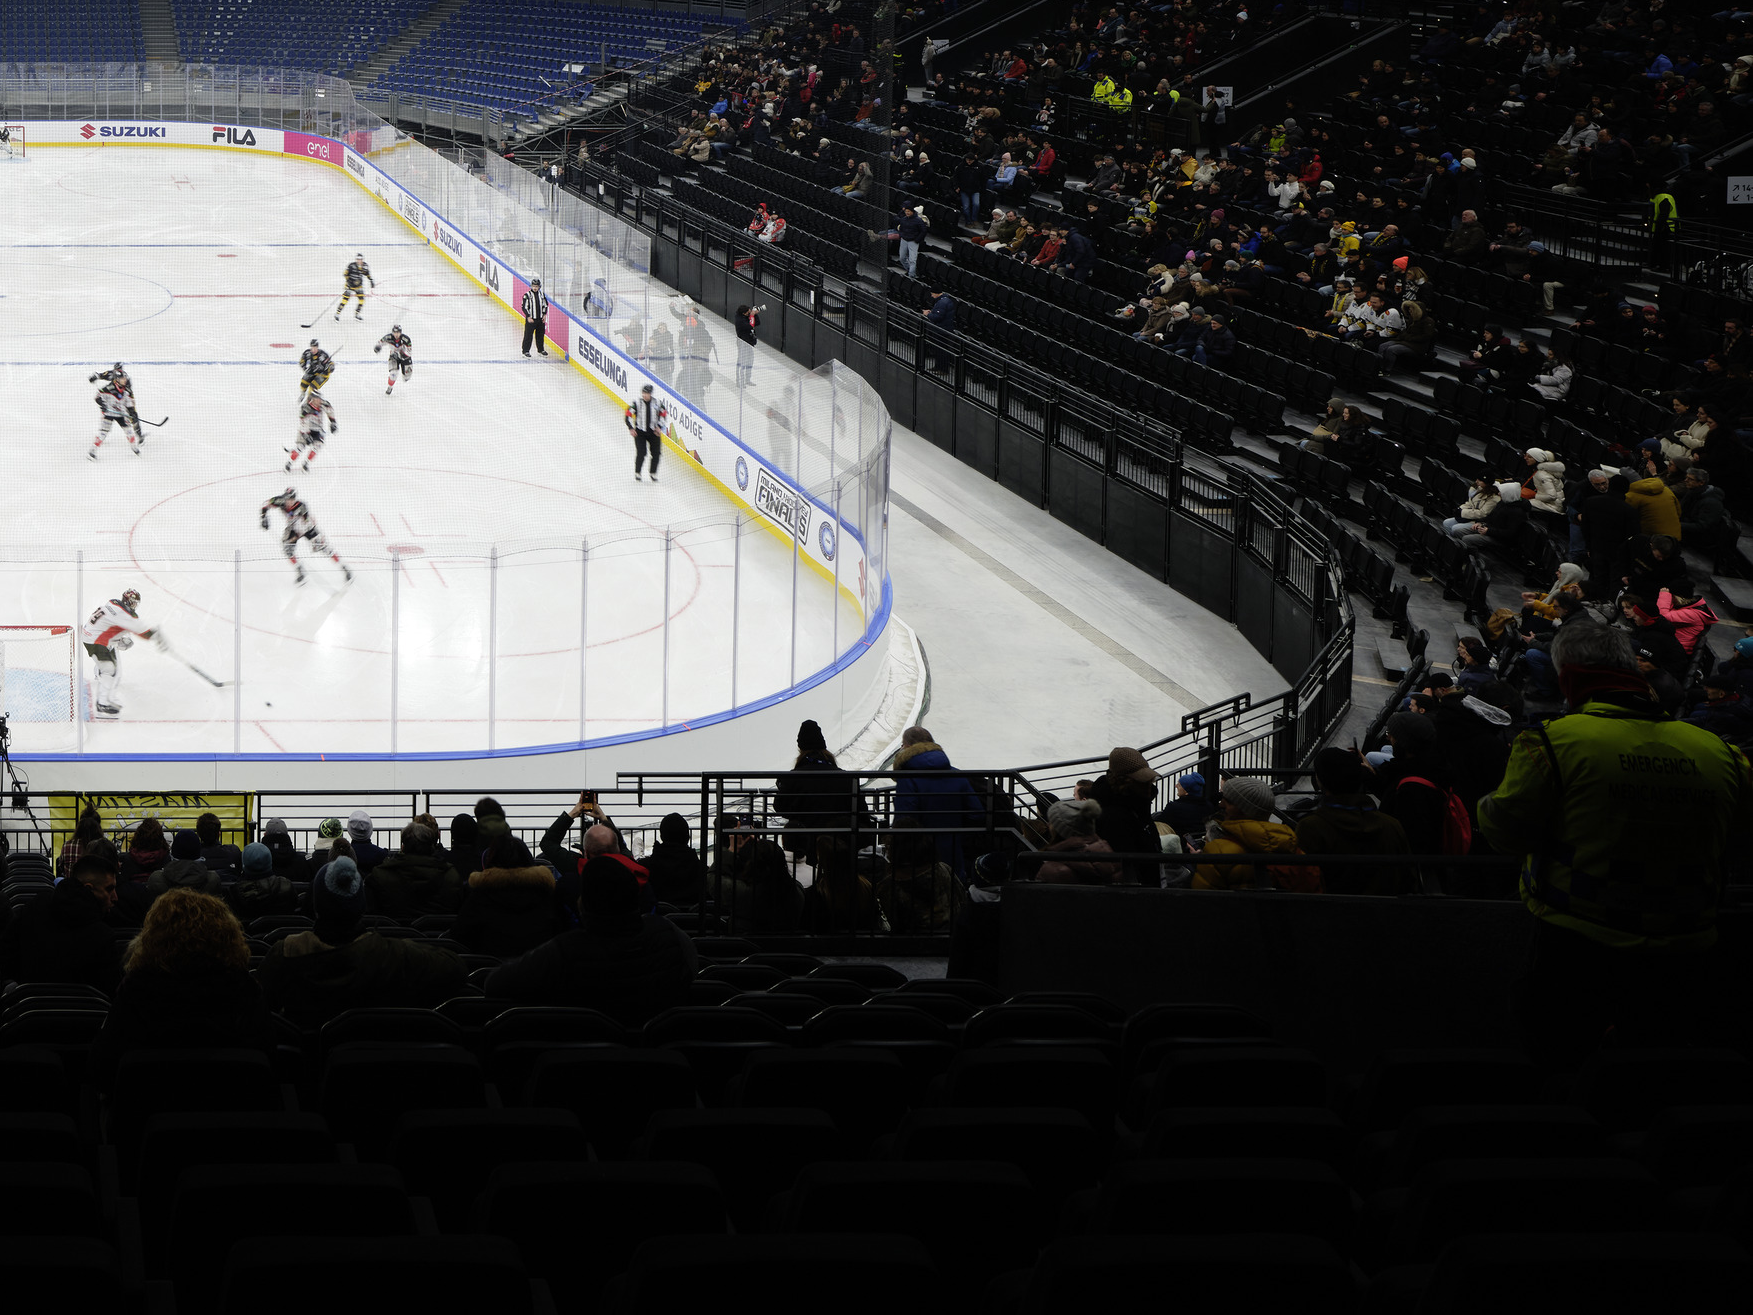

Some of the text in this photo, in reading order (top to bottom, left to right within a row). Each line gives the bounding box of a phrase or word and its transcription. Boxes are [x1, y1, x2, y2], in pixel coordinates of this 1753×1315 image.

[99, 126, 166, 138] SUZUKI
[212, 126, 257, 146] FILA
[307, 141, 330, 159] enel
[439, 227, 463, 258] SUZUKI
[479, 254, 500, 292] FILA
[578, 335, 628, 393] ESSELUNGA
[758, 485, 807, 537] FINALS
[760, 476, 809, 518] MILANO HOCEY
[1618, 754, 1698, 775] EMERGENCY
